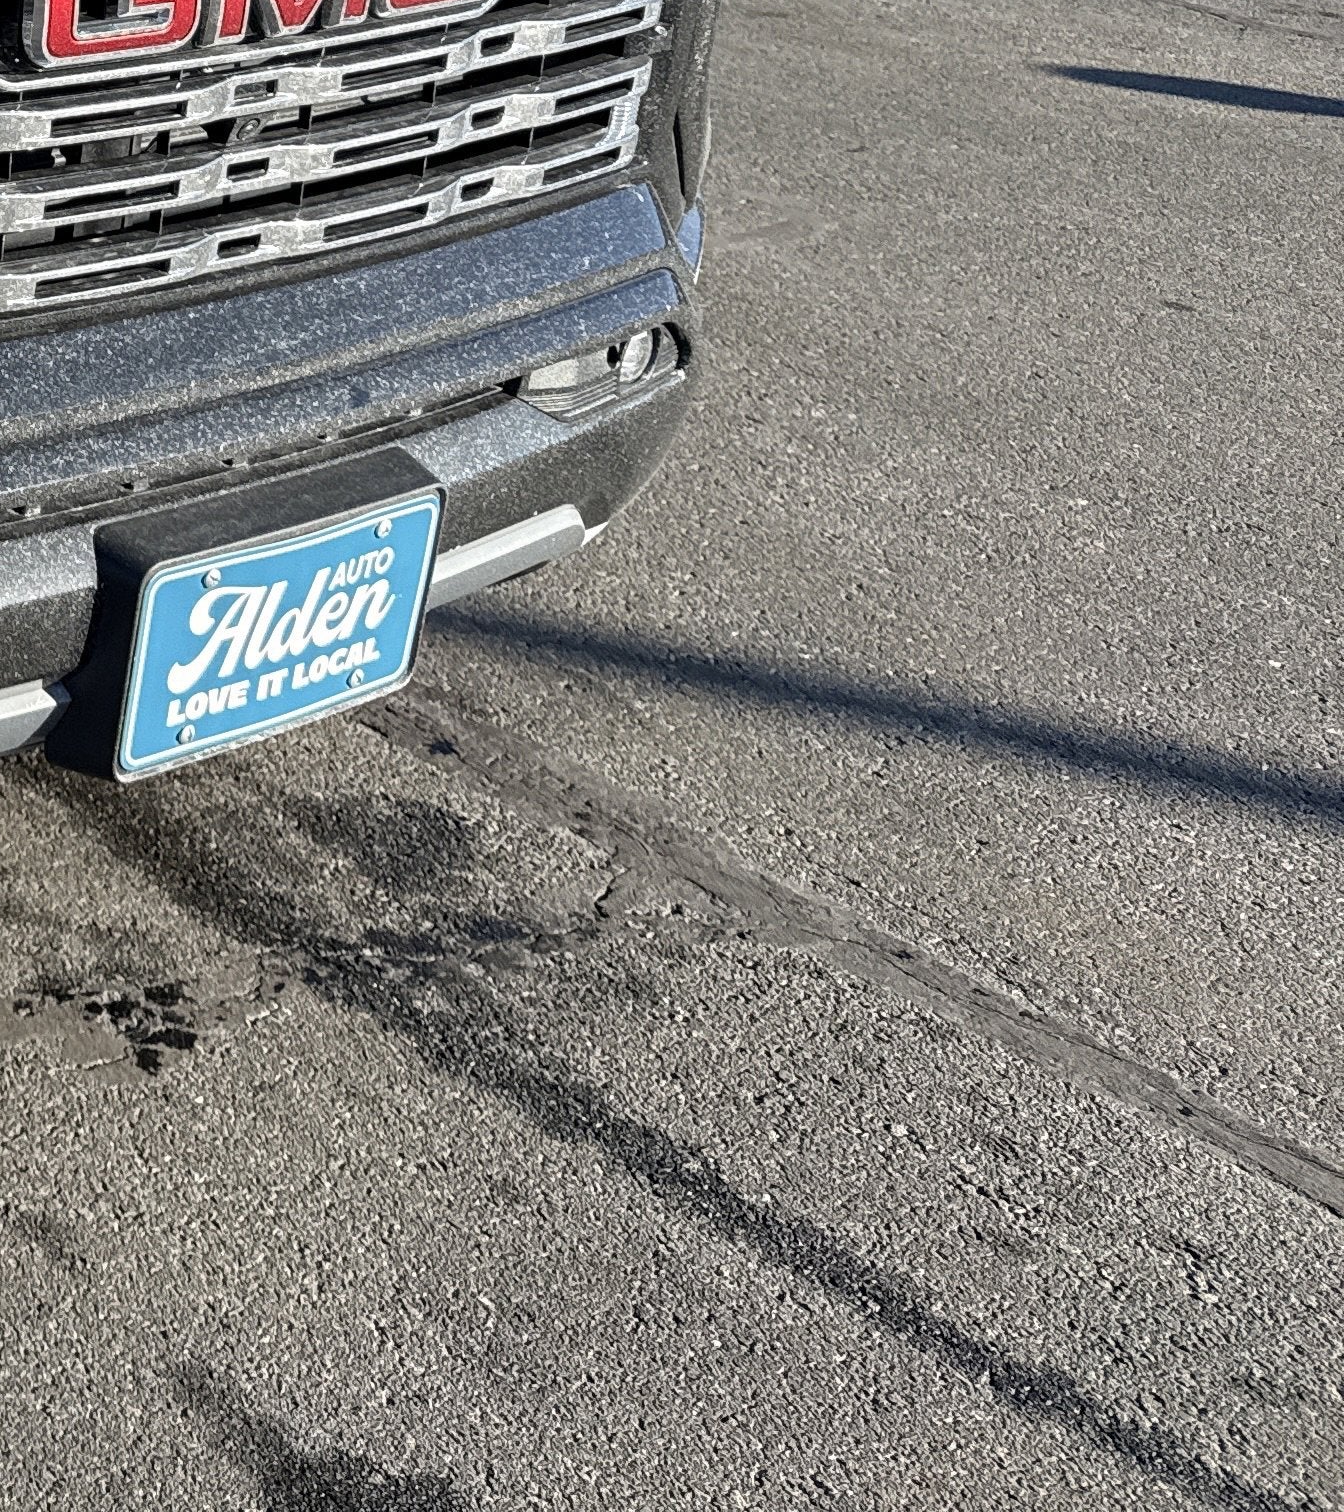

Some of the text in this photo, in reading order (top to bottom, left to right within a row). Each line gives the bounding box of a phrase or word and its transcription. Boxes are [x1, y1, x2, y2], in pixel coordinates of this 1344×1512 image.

[328, 546, 395, 591] AUTO
[166, 566, 396, 695] Alden
[165, 636, 381, 728] LOVE IT LOCAL
